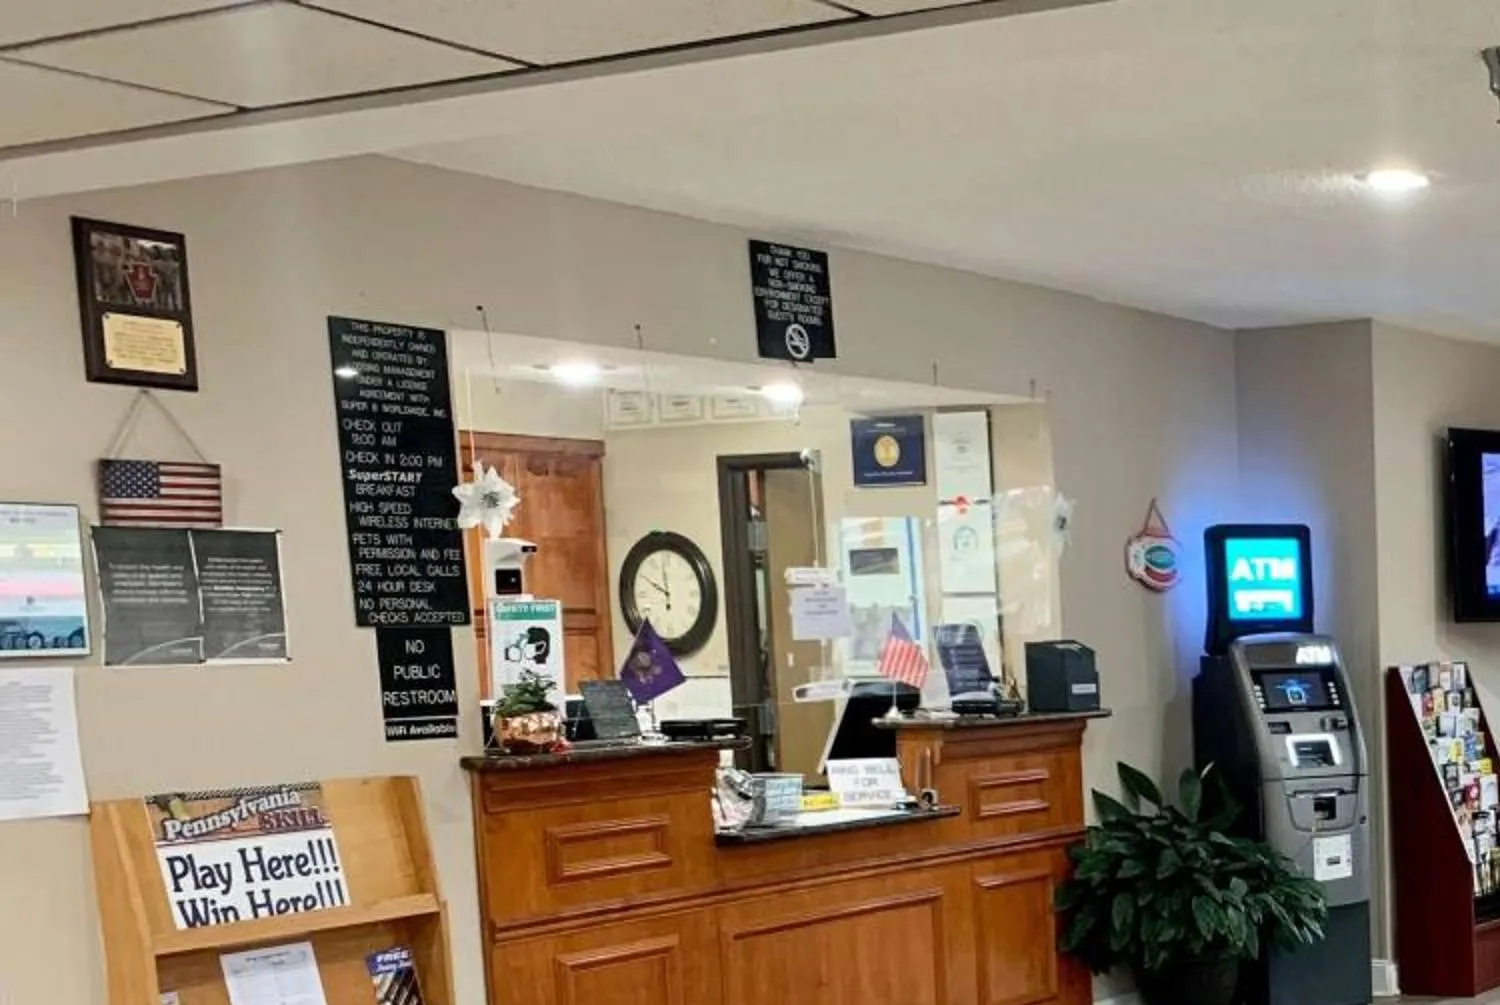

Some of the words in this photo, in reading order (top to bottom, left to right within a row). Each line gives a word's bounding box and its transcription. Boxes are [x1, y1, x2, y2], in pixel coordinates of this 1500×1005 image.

[373, 325, 414, 339] PROPERTY
[341, 334, 405, 349] INDEPENDENTLY
[351, 349, 369, 359] AND
[371, 351, 414, 364] OPERATED
[341, 400, 369, 411] SUPER
[342, 418, 377, 433] CHECK
[381, 421, 402, 433] OUT
[382, 435, 397, 446] AM
[345, 450, 380, 463] CHECK
[384, 452, 396, 465] IN
[399, 453, 423, 467] 2:00
[427, 455, 443, 468] PM
[347, 468, 423, 483] SuperSTART
[355, 483, 417, 497] BREAKFAST
[349, 501, 375, 513] HIGH
[378, 501, 412, 515] SPEED
[359, 515, 409, 529] WIRELESS
[352, 533, 381, 545] PETS
[386, 533, 413, 546] WITH
[359, 547, 417, 560] PERMISSION
[420, 548, 440, 560] AND
[443, 548, 461, 560] FEE
[355, 563, 382, 576] FREE
[387, 564, 421, 577] LOCAL
[427, 564, 460, 577] CALLS
[1231, 556, 1296, 581] ATM
[358, 580, 372, 593] 24
[377, 581, 405, 593] HOUR
[409, 581, 437, 593] DESK
[360, 597, 375, 609] NO
[379, 597, 432, 610] PERSONAL
[368, 611, 408, 624] CHECKS
[414, 611, 465, 623] ACCEPTED
[405, 639, 425, 654] NO
[393, 664, 441, 680] PUBLIC
[383, 689, 456, 706] RESTROOM
[163, 788, 300, 841] Pennsylvania
[258, 806, 324, 832] SKILL
[166, 853, 232, 895] Play
[238, 838, 339, 884] Here!!!
[176, 897, 240, 929] Win
